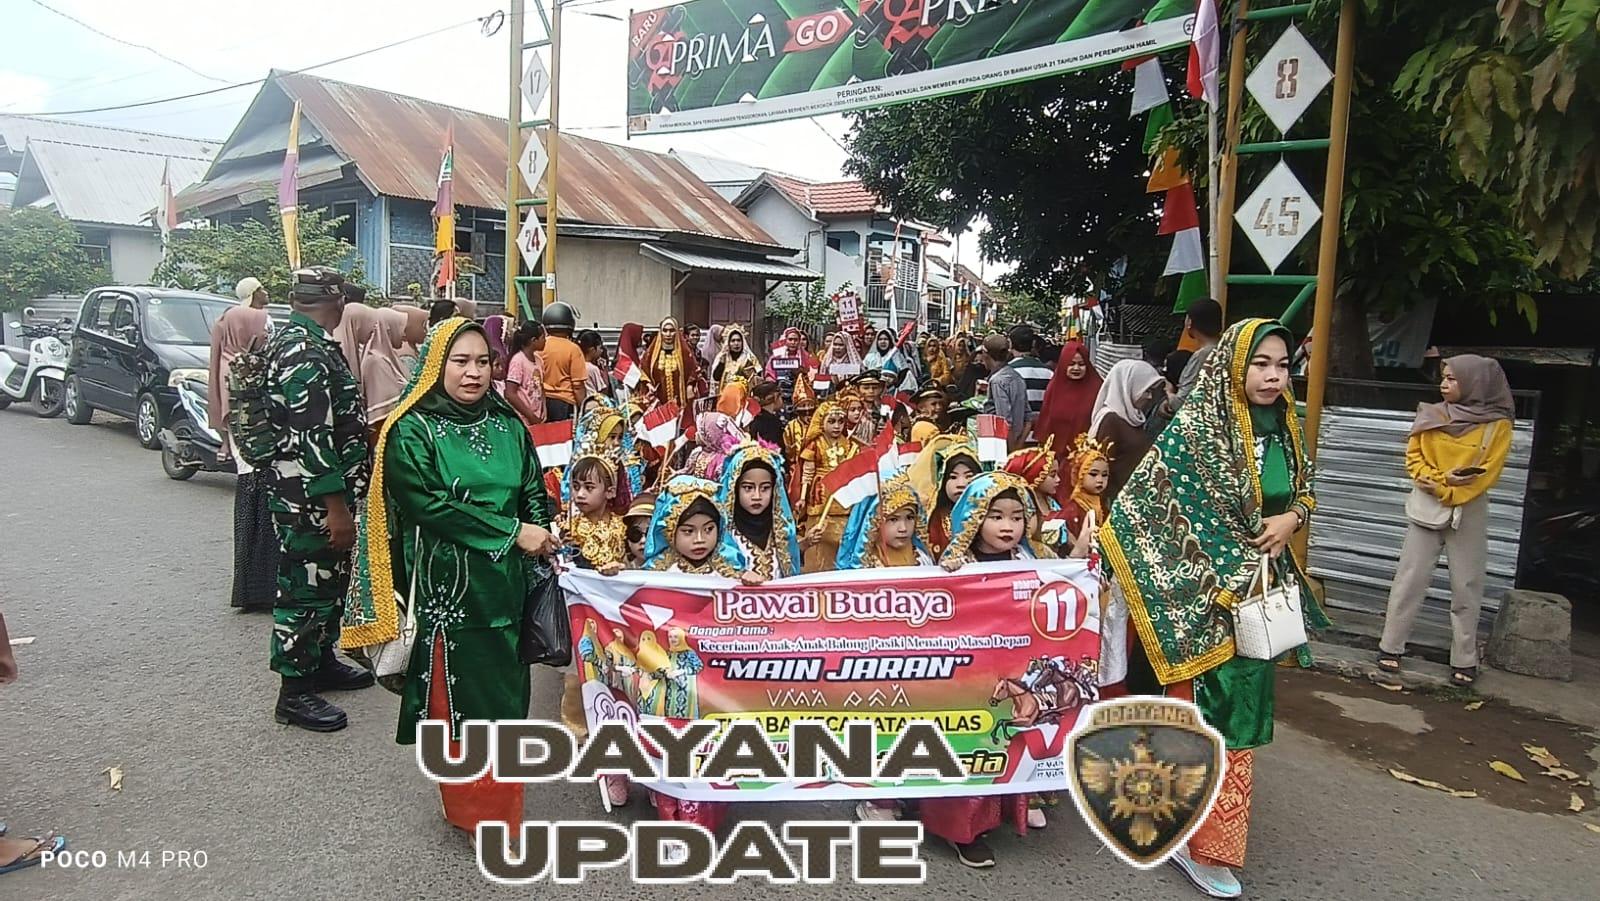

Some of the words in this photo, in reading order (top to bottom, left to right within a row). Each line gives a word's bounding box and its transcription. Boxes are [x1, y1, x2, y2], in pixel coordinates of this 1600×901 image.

[632, 11, 657, 47] BARU
[670, 23, 776, 76] PRIMA
[795, 14, 838, 46] GO
[529, 69, 542, 95] 17
[895, 87, 919, 96] MENJUAL
[932, 80, 958, 89] MEMBERI
[958, 75, 981, 85] KEPADA
[981, 71, 1003, 80] ORANG
[1011, 65, 1033, 75] BAWAH
[1033, 62, 1048, 71] USIA
[1057, 55, 1078, 65] TAHUN
[1094, 45, 1135, 58] PEREMPUAN
[1136, 39, 1157, 49] HAMIL
[1275, 58, 1298, 99] 8
[837, 85, 883, 98] PERINGATAN:
[528, 150, 538, 175] 8
[1253, 196, 1301, 237] 45
[525, 227, 541, 253] 24
[717, 588, 817, 618] Pawai
[828, 588, 951, 623] Budaya
[1039, 588, 1078, 632] 11
[700, 639, 759, 652] Keceriaan
[762, 638, 825, 651] Anak-Anak
[828, 637, 868, 652] Balong
[871, 636, 904, 649] Pasiki
[907, 636, 957, 651] Menatap
[960, 635, 991, 648] Masa
[994, 634, 1029, 649] Depan
